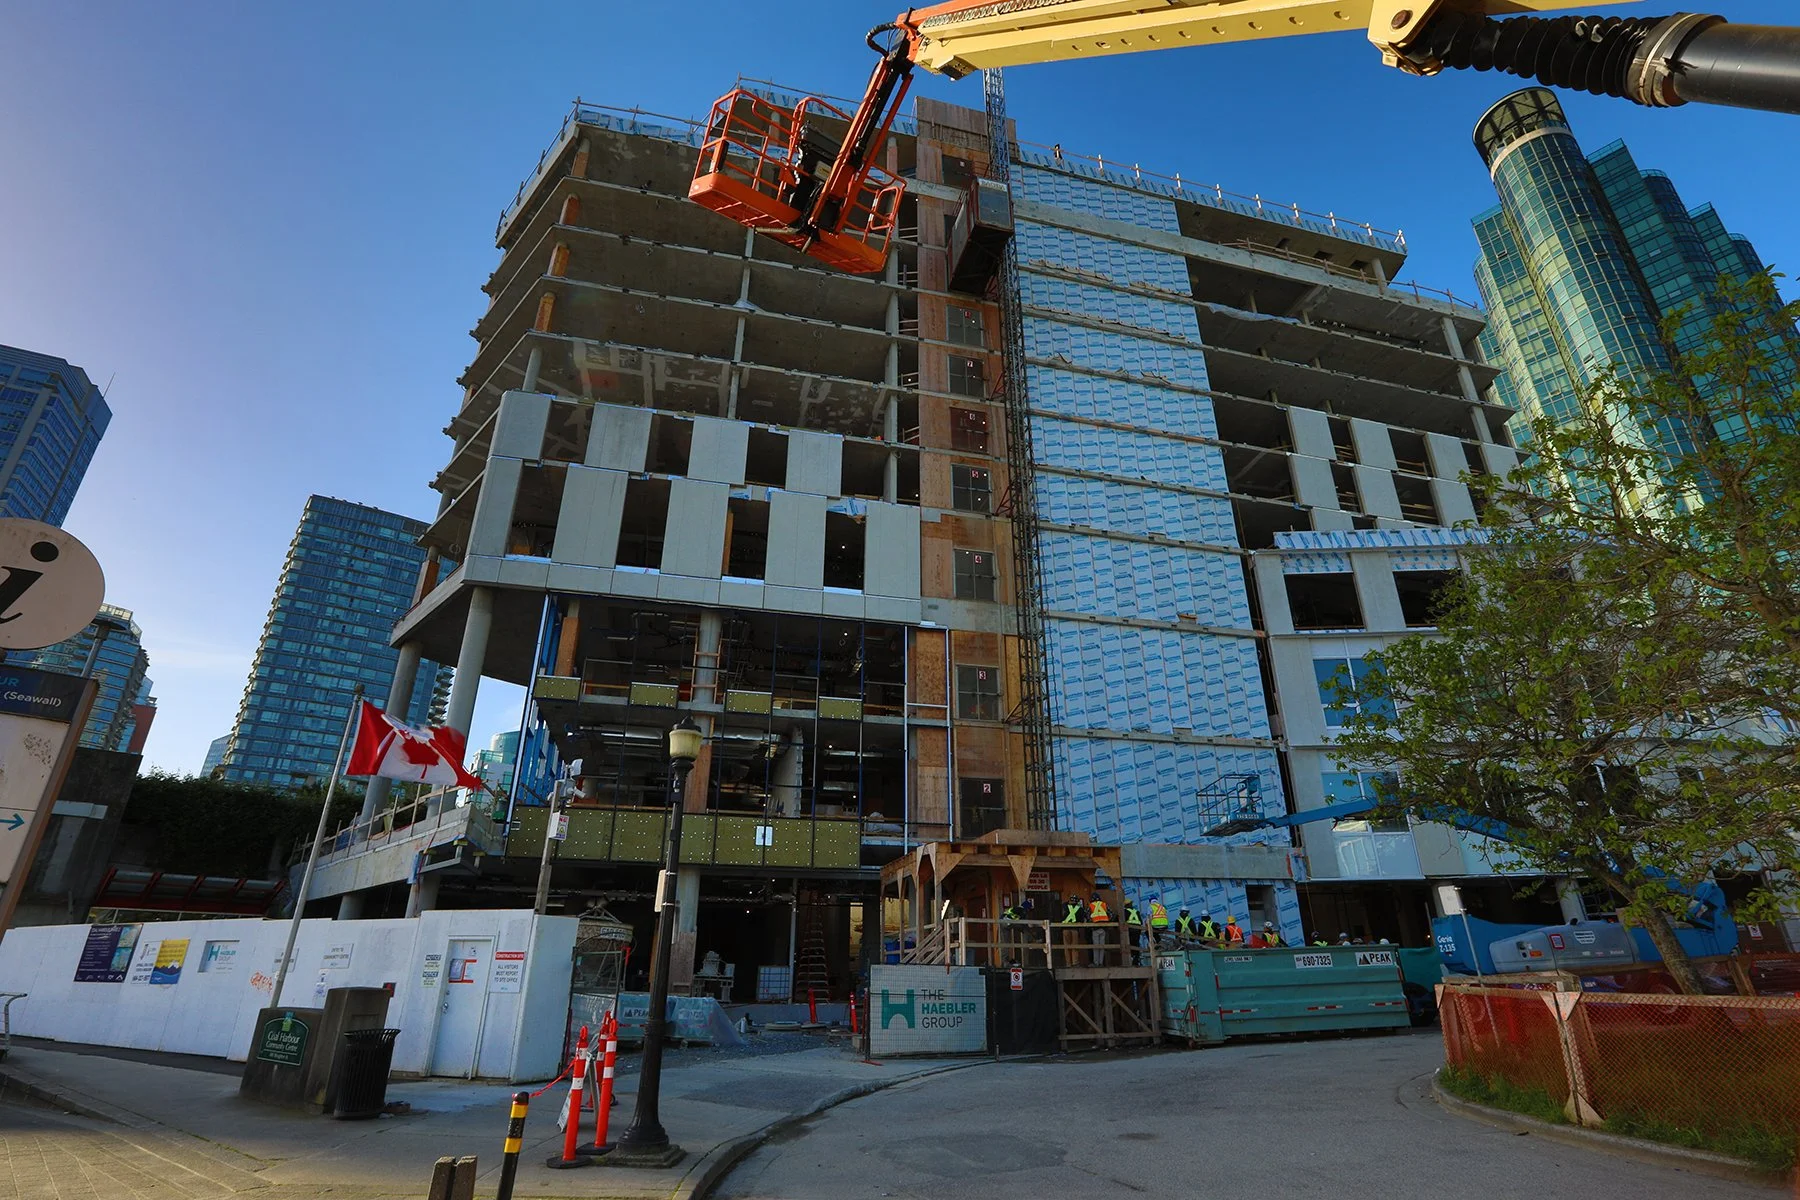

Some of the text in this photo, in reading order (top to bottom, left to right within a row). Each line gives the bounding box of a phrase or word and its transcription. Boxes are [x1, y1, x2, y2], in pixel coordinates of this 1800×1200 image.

[979, 671, 986, 680] 3
[4, 690, 62, 708] (Seawall)
[984, 784, 991, 793] 2
[1163, 958, 1174, 968] PEAK
[1302, 955, 1331, 966] 690-7325
[1369, 952, 1392, 963] PEAK
[921, 989, 944, 1001] THE
[922, 1002, 977, 1014] HAEBLER
[921, 1016, 963, 1029] GROUP
[268, 1031, 300, 1043] Coal Harbour
[266, 1041, 298, 1051] Community Centre
